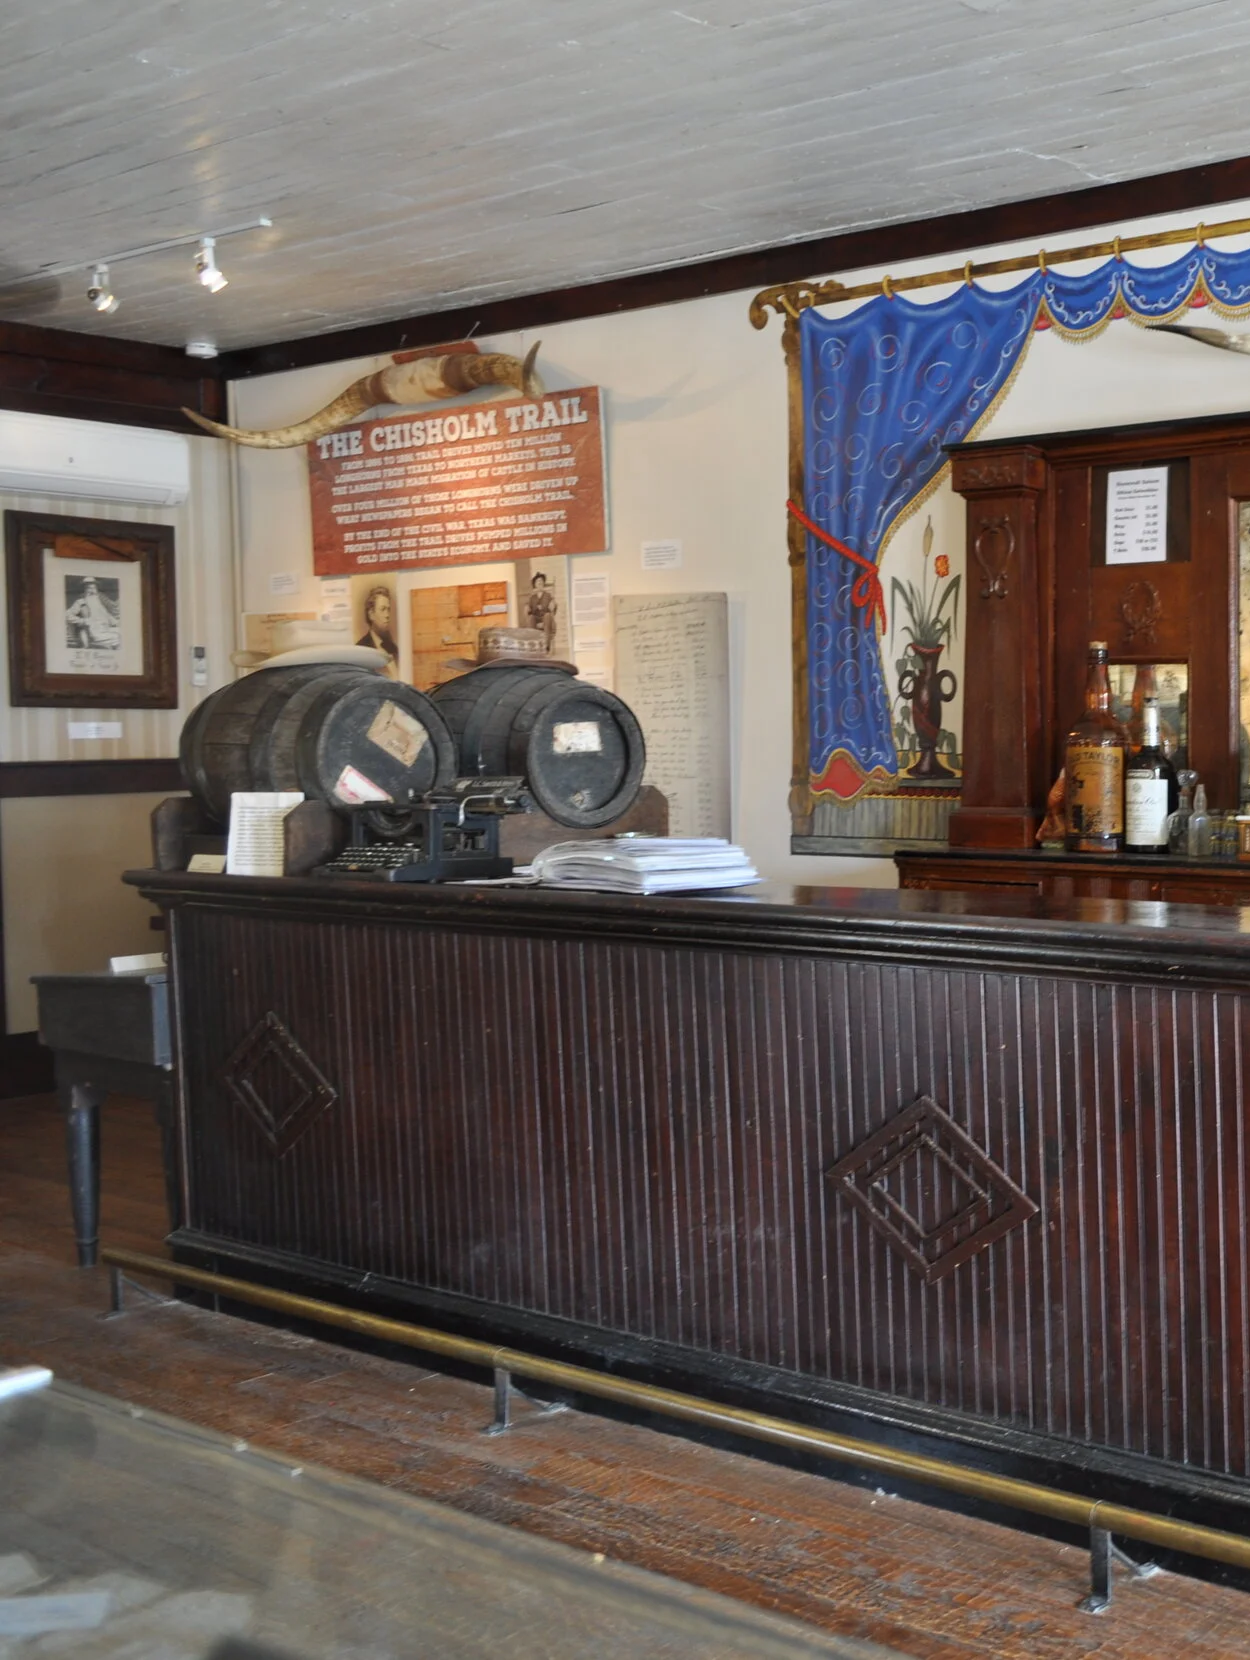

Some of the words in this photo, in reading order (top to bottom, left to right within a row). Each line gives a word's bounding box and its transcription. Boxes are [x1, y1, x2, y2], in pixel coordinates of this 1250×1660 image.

[316, 430, 364, 460] THE
[370, 410, 499, 452] CHISHOLM
[505, 396, 588, 433] TRAIL
[524, 432, 562, 446] MILLION
[407, 463, 433, 474] TEXAS
[491, 463, 524, 476] CATTLE
[565, 476, 579, 486] UP
[456, 501, 478, 512] CALL
[499, 493, 543, 507] CHISHOLM
[467, 518, 496, 529] TEXAS
[1085, 751, 1120, 764] TAYLOR
